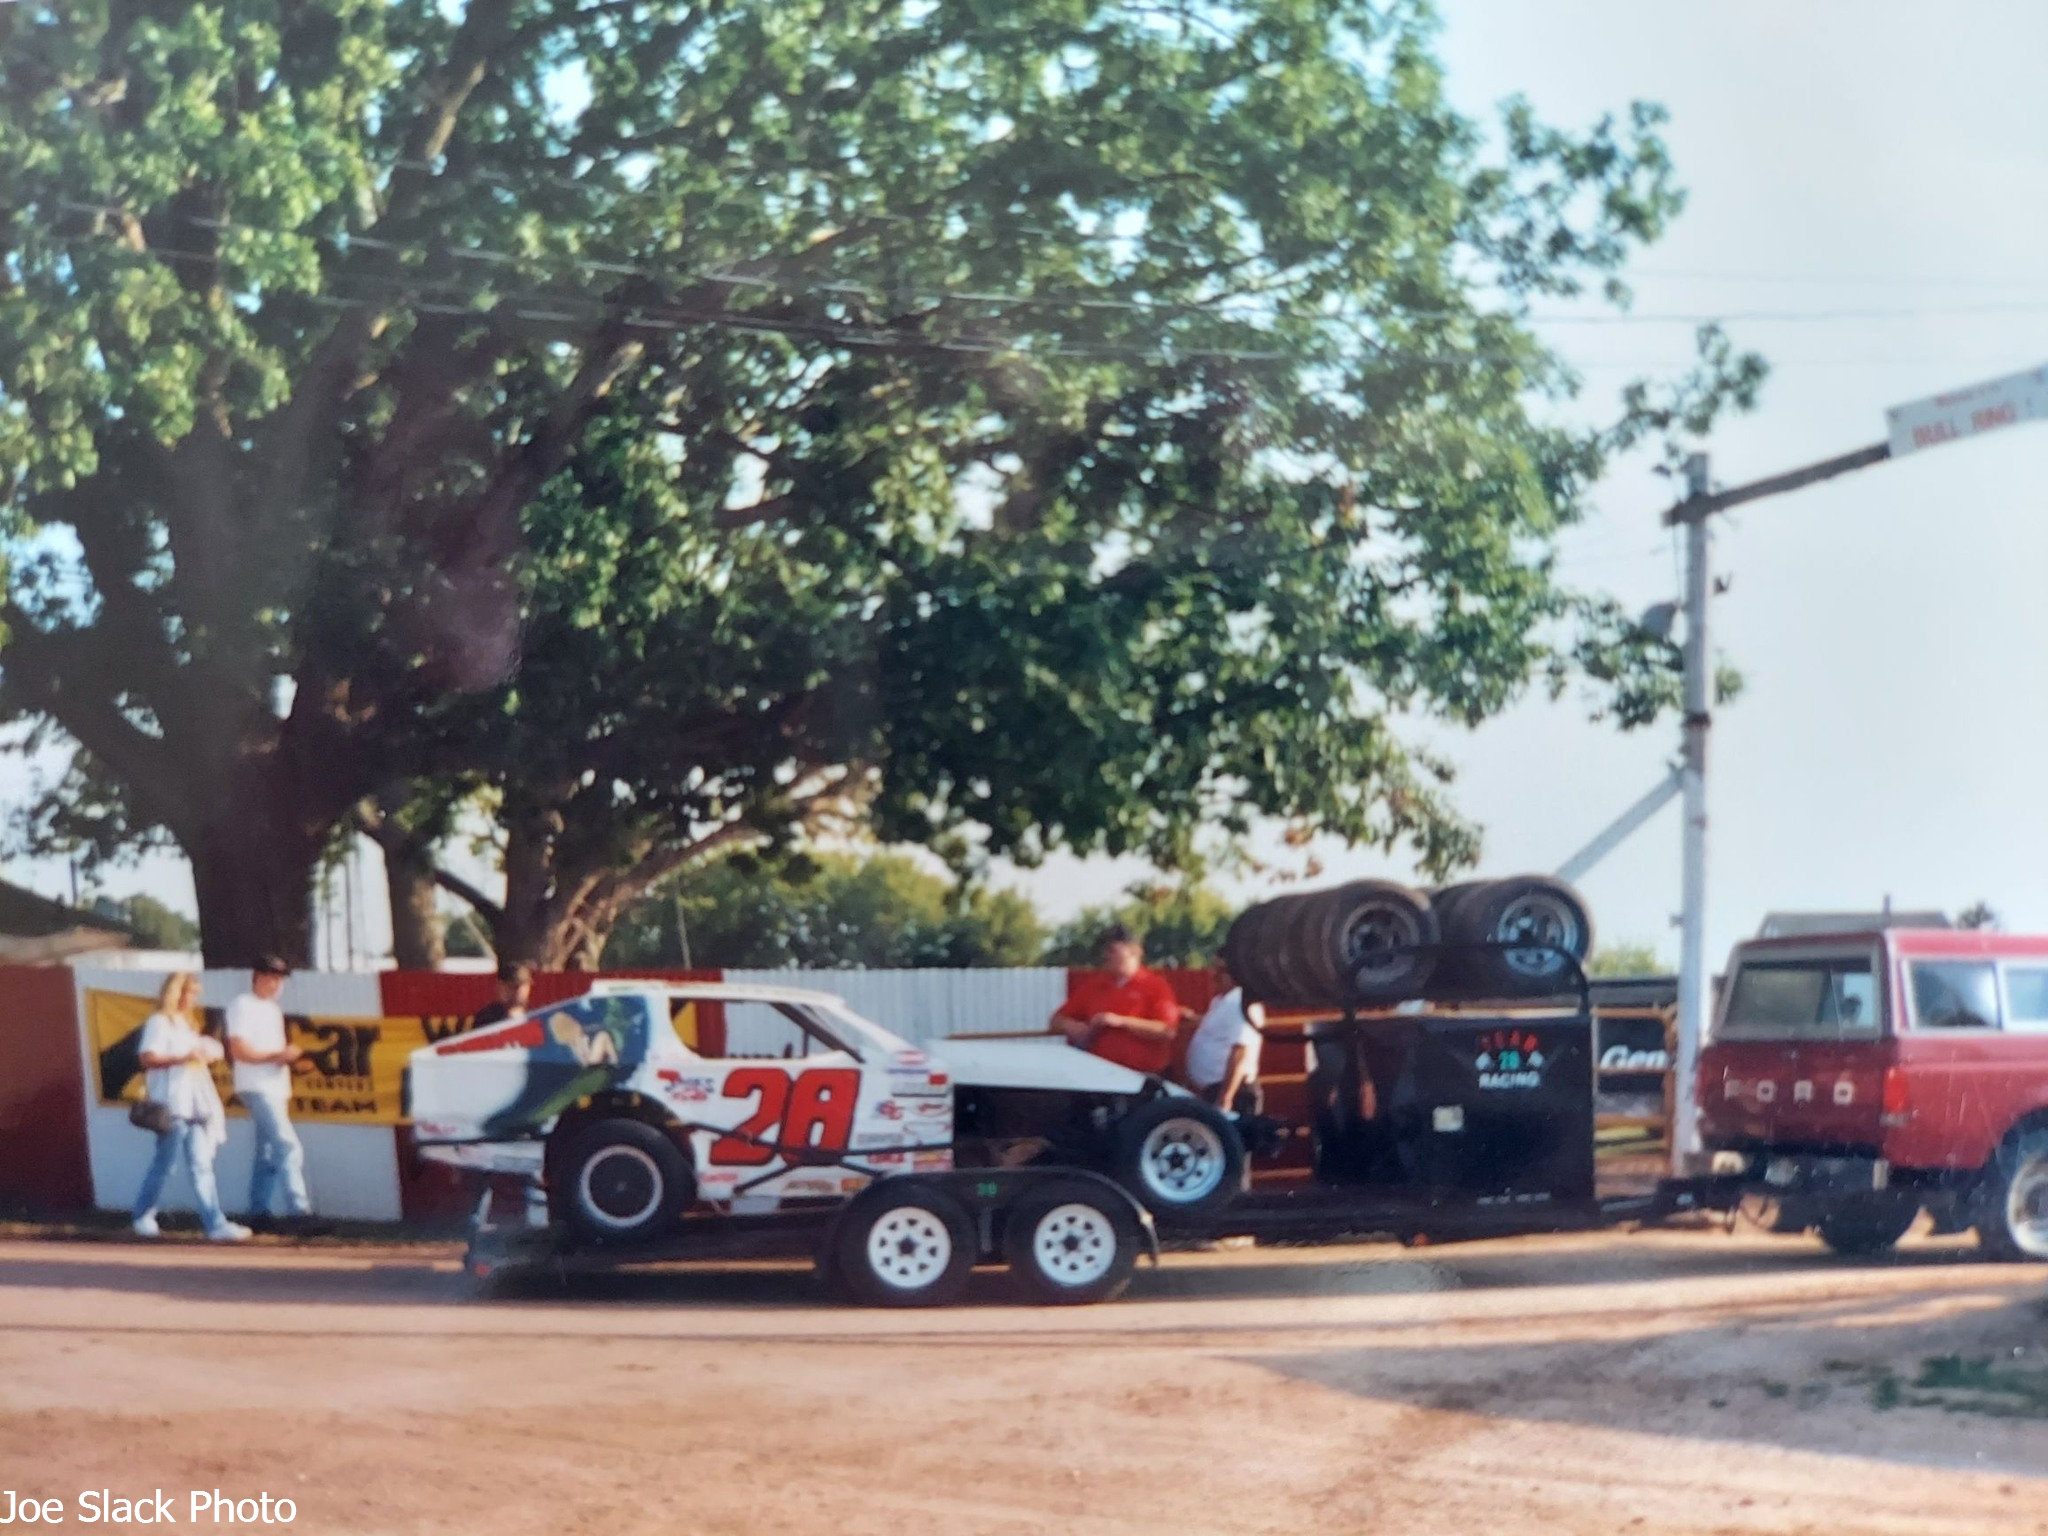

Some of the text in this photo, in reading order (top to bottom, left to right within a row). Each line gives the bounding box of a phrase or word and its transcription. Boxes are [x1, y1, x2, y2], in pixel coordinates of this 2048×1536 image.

[1724, 1079, 1855, 1105] FORD
[294, 1097, 377, 1114] TEAM
[709, 1067, 861, 1167] 28
